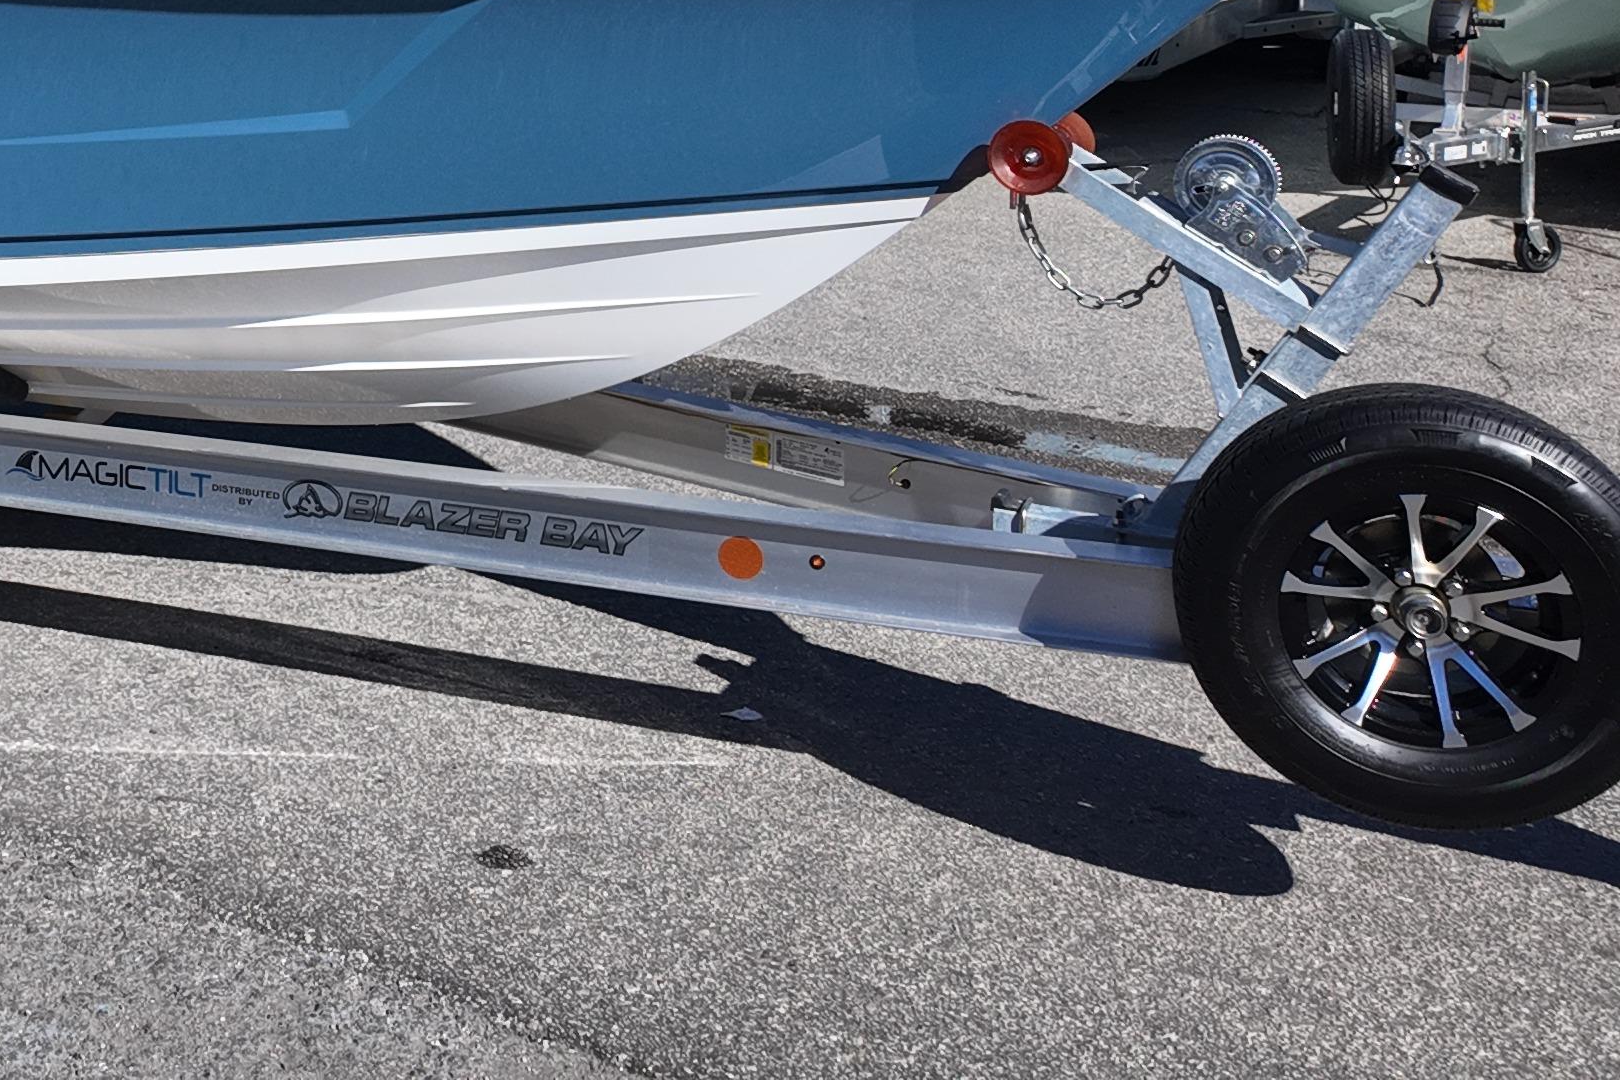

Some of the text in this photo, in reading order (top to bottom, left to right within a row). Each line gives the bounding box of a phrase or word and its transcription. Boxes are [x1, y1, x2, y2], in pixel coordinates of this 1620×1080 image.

[211, 482, 281, 501] DISTRIBUTED
[238, 496, 254, 506] BY
[343, 491, 645, 557] BLAZER BAY
